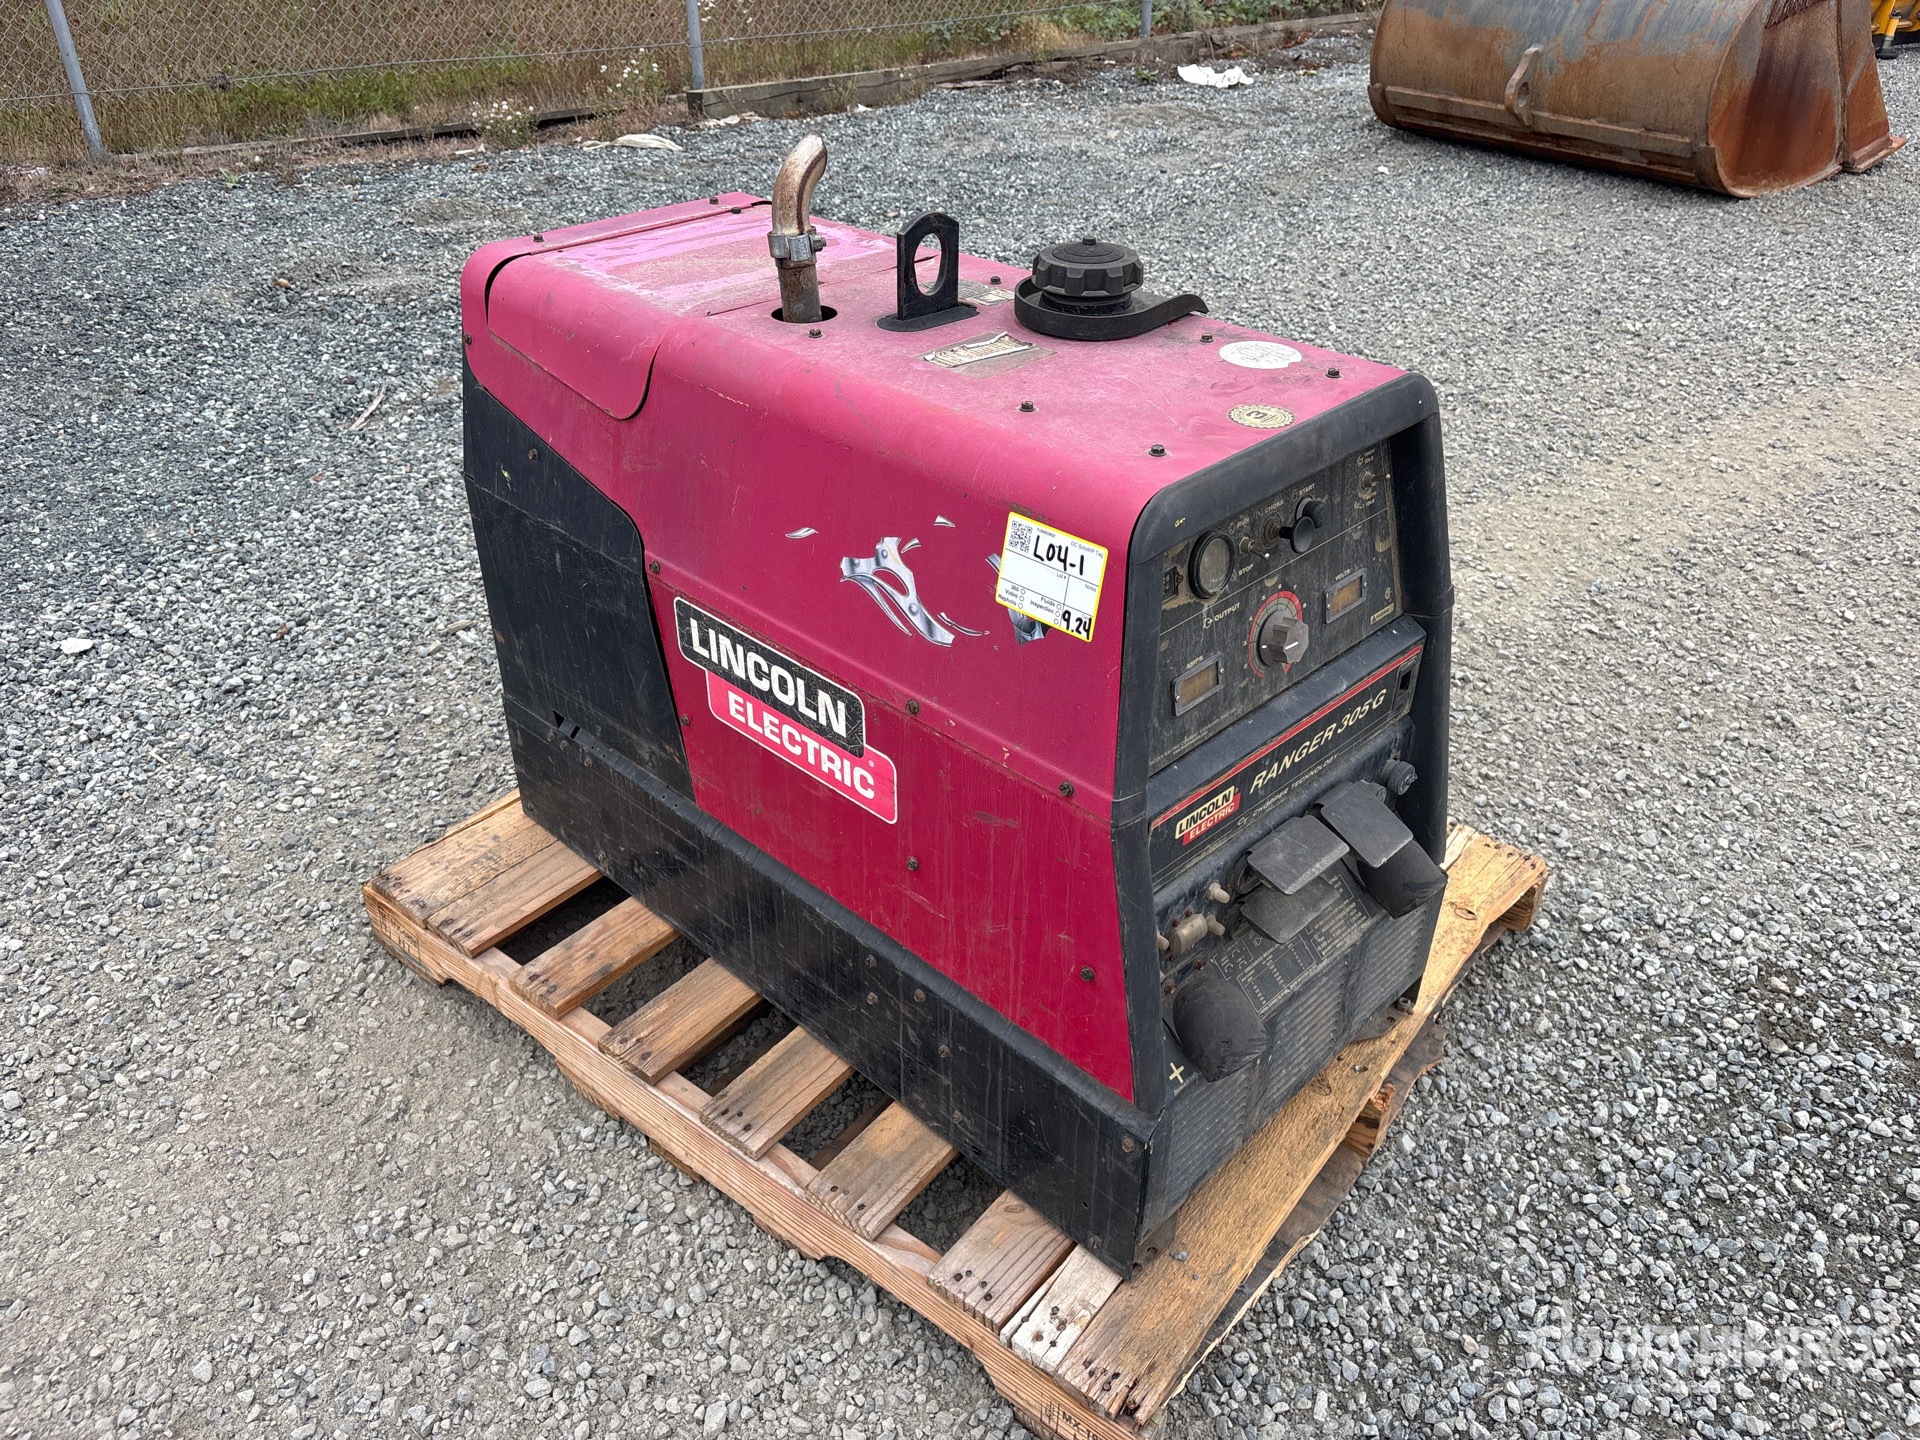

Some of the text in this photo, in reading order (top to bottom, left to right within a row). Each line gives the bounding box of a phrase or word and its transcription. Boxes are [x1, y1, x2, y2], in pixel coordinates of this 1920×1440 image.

[1298, 482, 1316, 497] START
[1264, 499, 1285, 515] CHOKE
[1238, 563, 1254, 576] STOP
[1335, 568, 1351, 582] VOLTS
[1005, 588, 1019, 599] Video
[1040, 596, 1056, 608] Fluids
[1029, 599, 1055, 614] Inspection
[1214, 601, 1241, 622] OUTPUT
[1062, 609, 1093, 641] 9.24
[1186, 655, 1204, 669] AMPS
[690, 617, 848, 738] LINCOLN
[727, 690, 875, 800] ELECTRIC
[1249, 723, 1337, 795] RANGER
[1253, 788, 1289, 817] CHOPPER
[1291, 753, 1339, 789] TECHNOLOGY
[1178, 786, 1234, 836] LINCOLN
[1188, 802, 1235, 840] ELECTRIC
